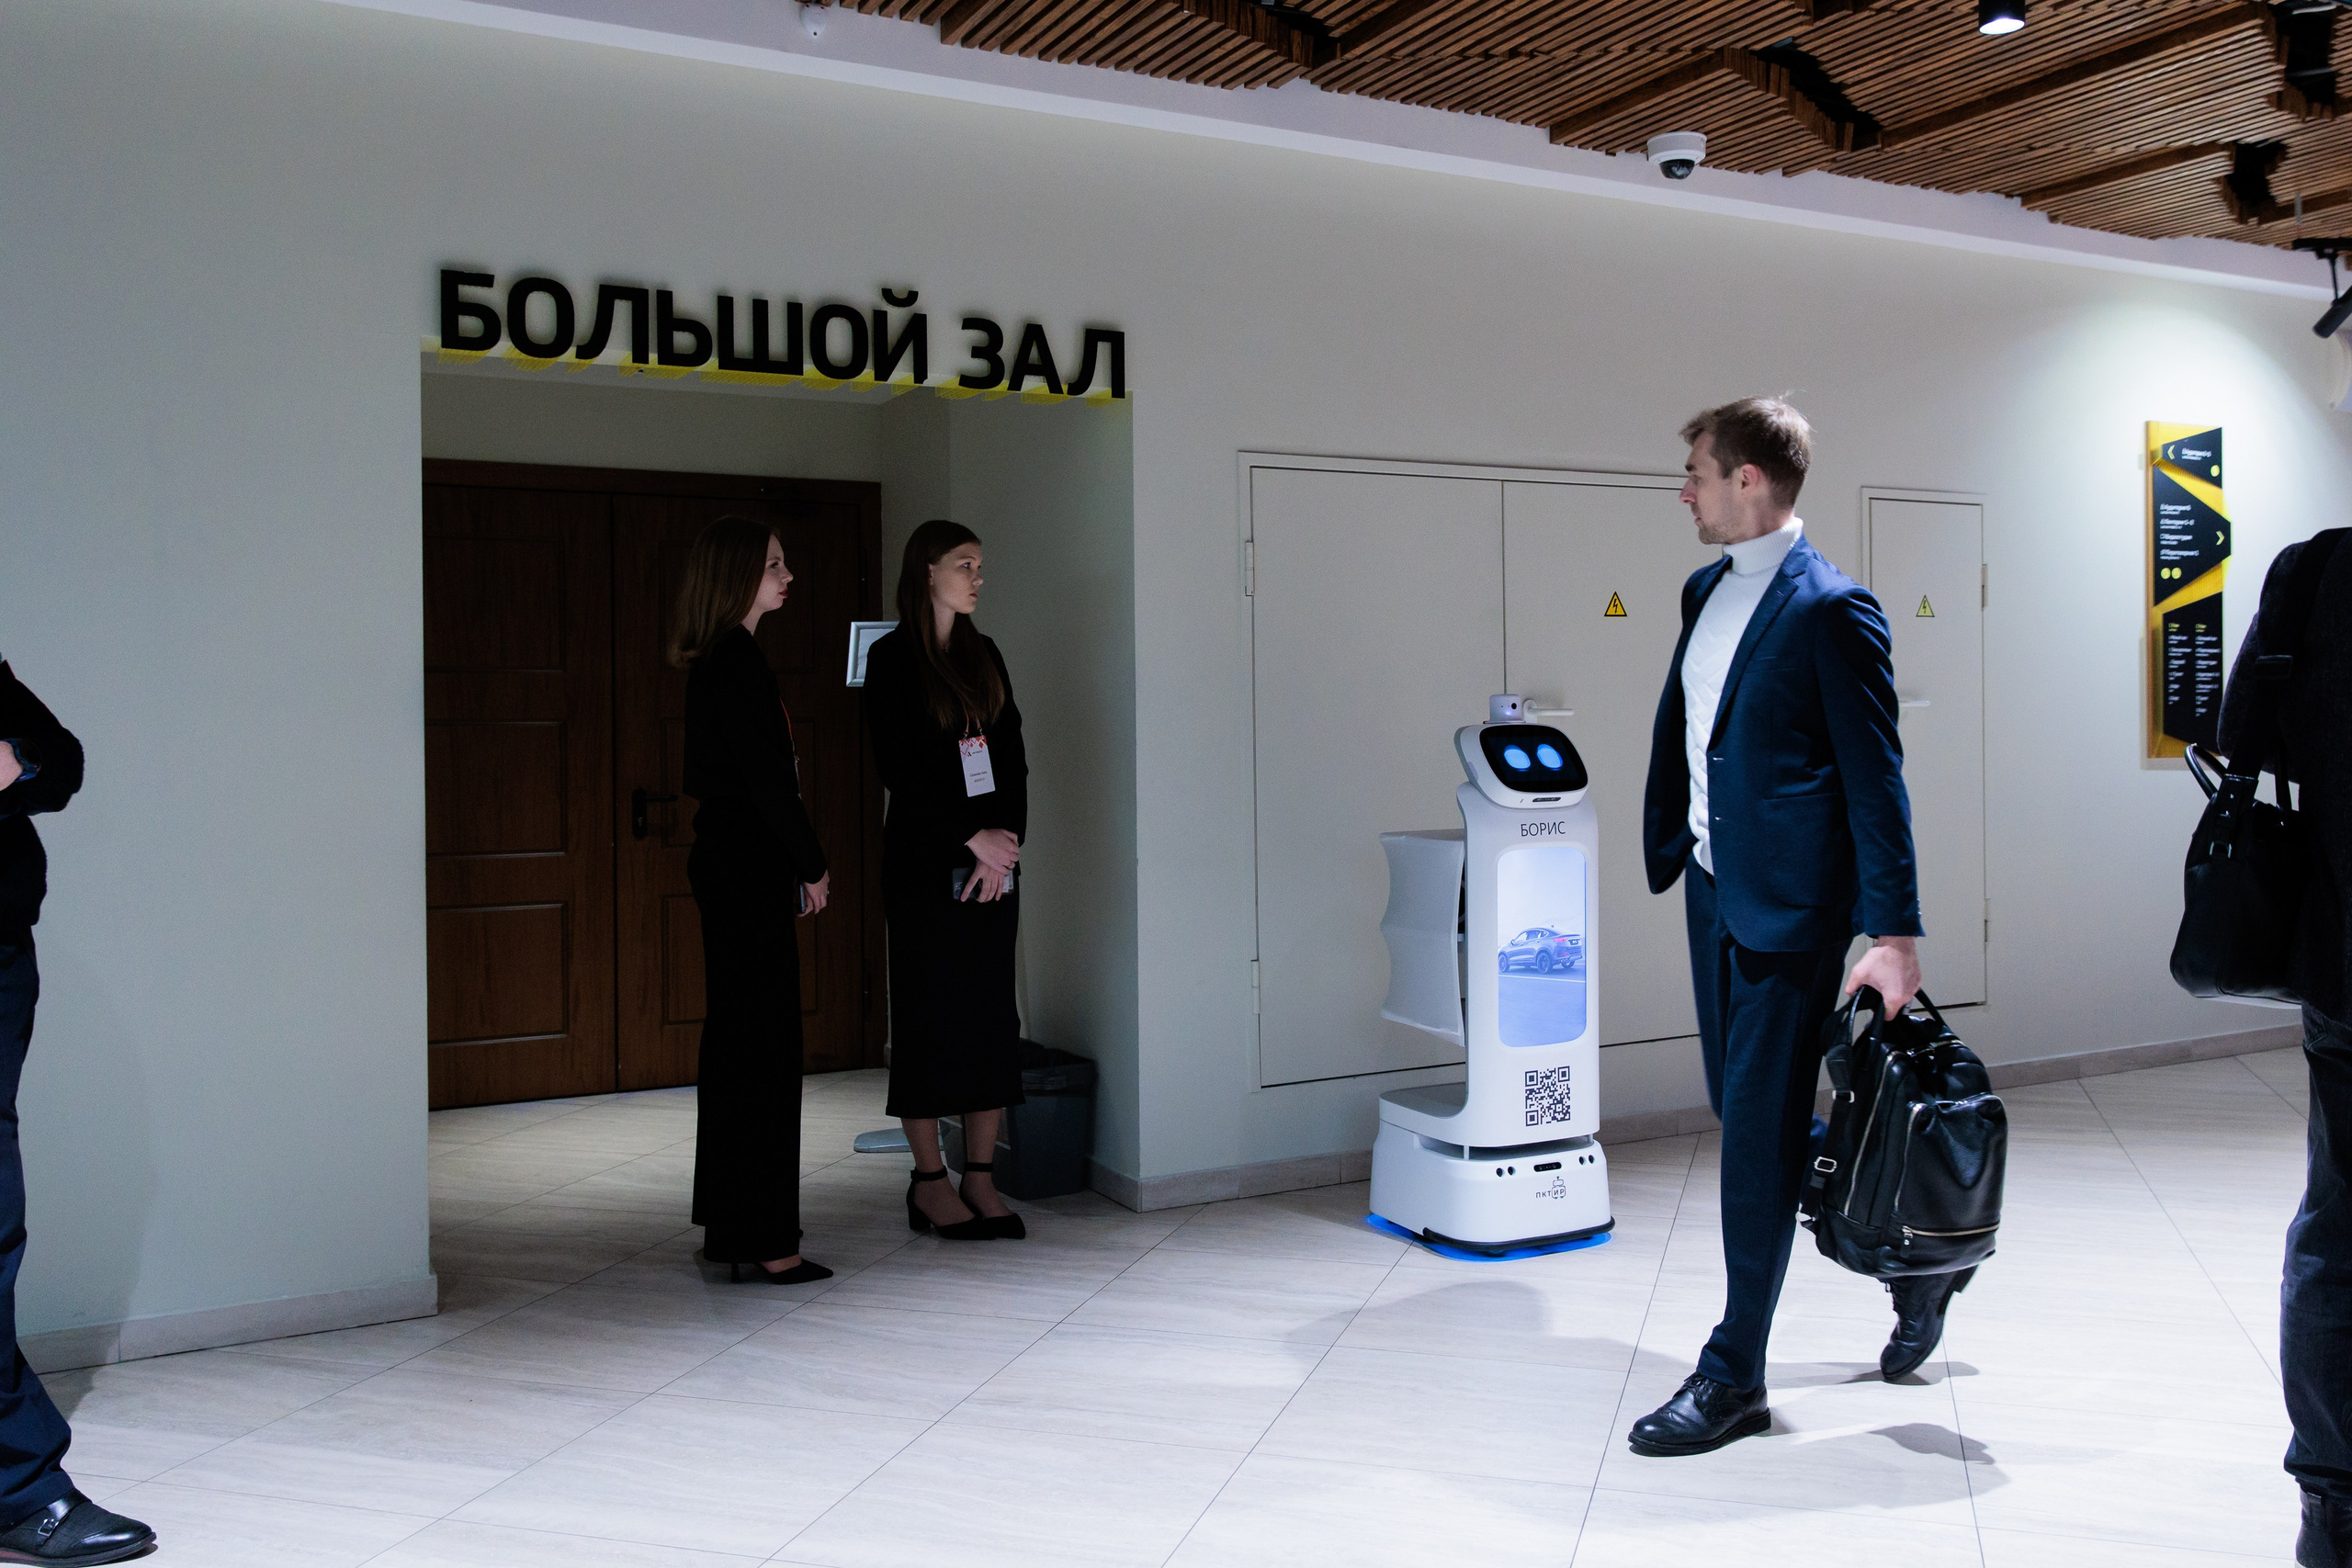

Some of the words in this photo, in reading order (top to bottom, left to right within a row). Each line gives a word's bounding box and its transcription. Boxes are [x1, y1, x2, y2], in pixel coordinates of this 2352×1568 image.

[440, 269, 928, 385] БОЛЬШОЙ
[958, 317, 1125, 399] ЗАЛ
[1521, 821, 1566, 837] БОРИС
